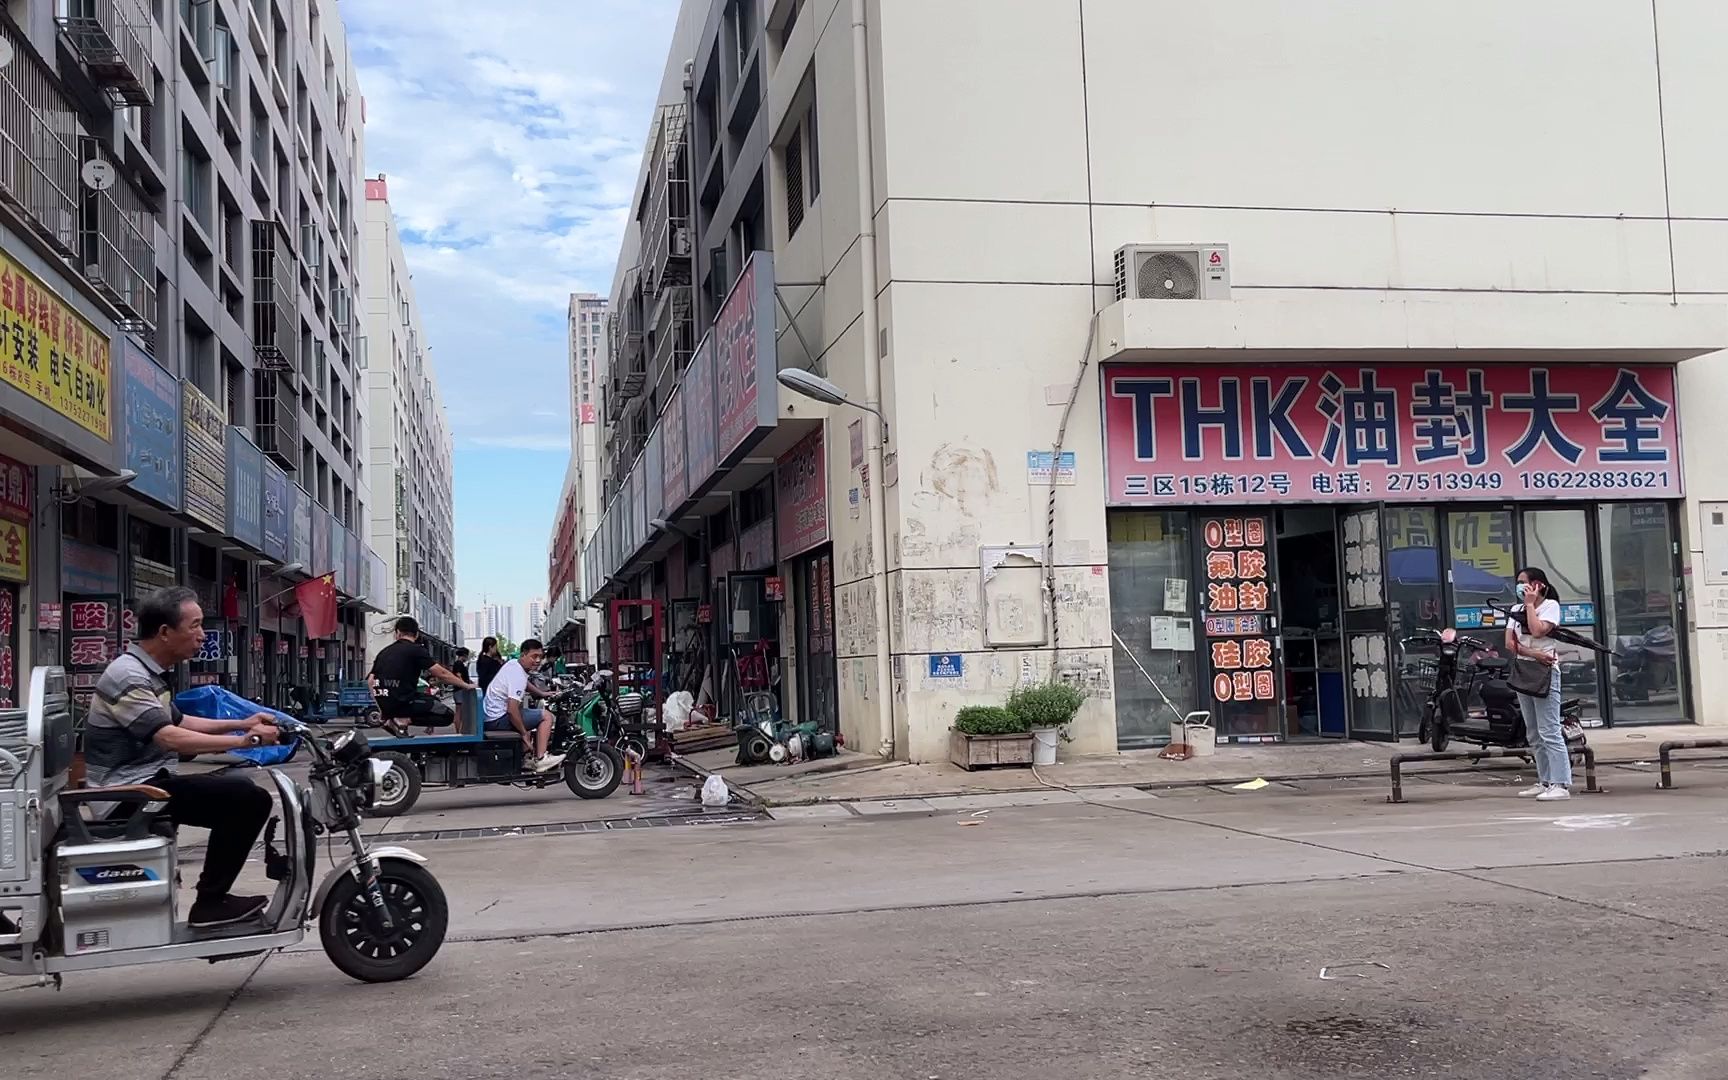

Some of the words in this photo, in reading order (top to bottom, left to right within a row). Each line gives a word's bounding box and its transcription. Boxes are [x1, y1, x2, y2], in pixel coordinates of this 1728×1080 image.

[1111, 368, 1670, 467] THK油封大全
[1125, 473, 1291, 496] 三区15栋12号
[1387, 471, 1502, 492] 27513949
[1519, 470, 1670, 489] 18622883621
[1209, 581, 1268, 611] 油封
[1212, 639, 1272, 668] 硅胶
